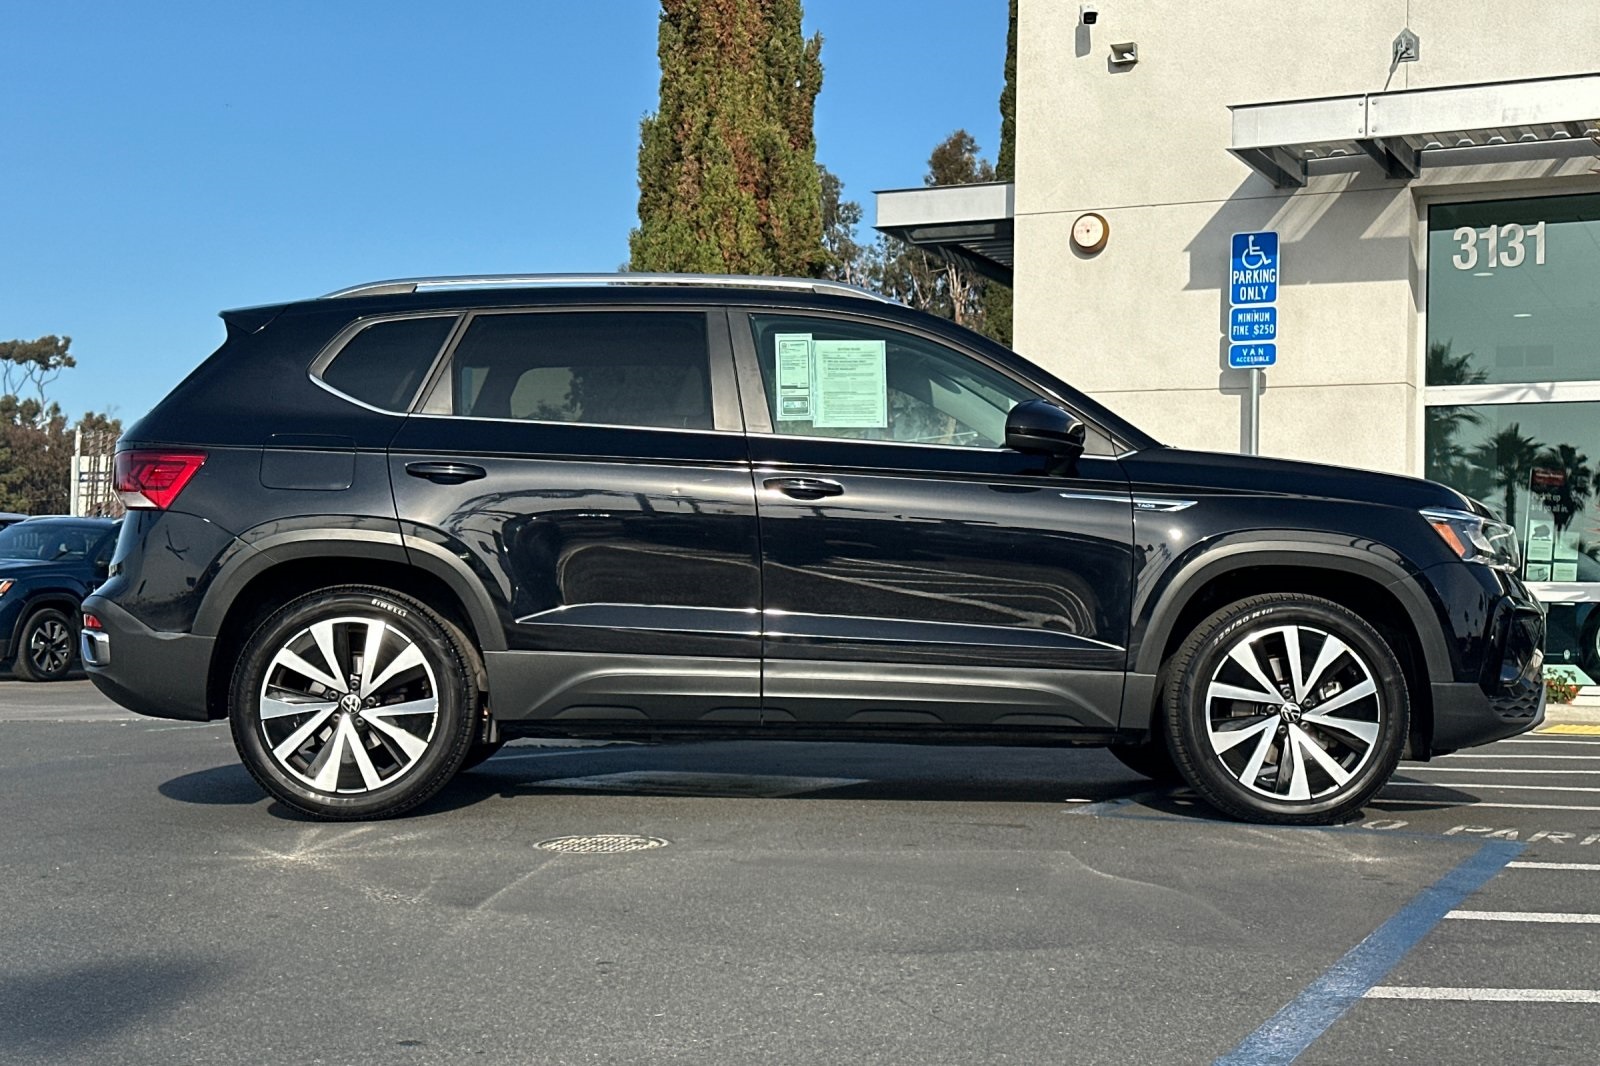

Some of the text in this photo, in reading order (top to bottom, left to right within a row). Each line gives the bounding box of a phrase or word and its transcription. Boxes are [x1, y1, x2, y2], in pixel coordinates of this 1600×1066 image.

[1452, 221, 1545, 270] 3131
[1232, 268, 1276, 285] PARKING
[1239, 286, 1268, 301] ONLY
[1237, 312, 1270, 322] MINIMUM
[1232, 324, 1274, 336] FINE $250
[1242, 348, 1264, 356] VAN
[371, 598, 407, 617] PIRELLI
